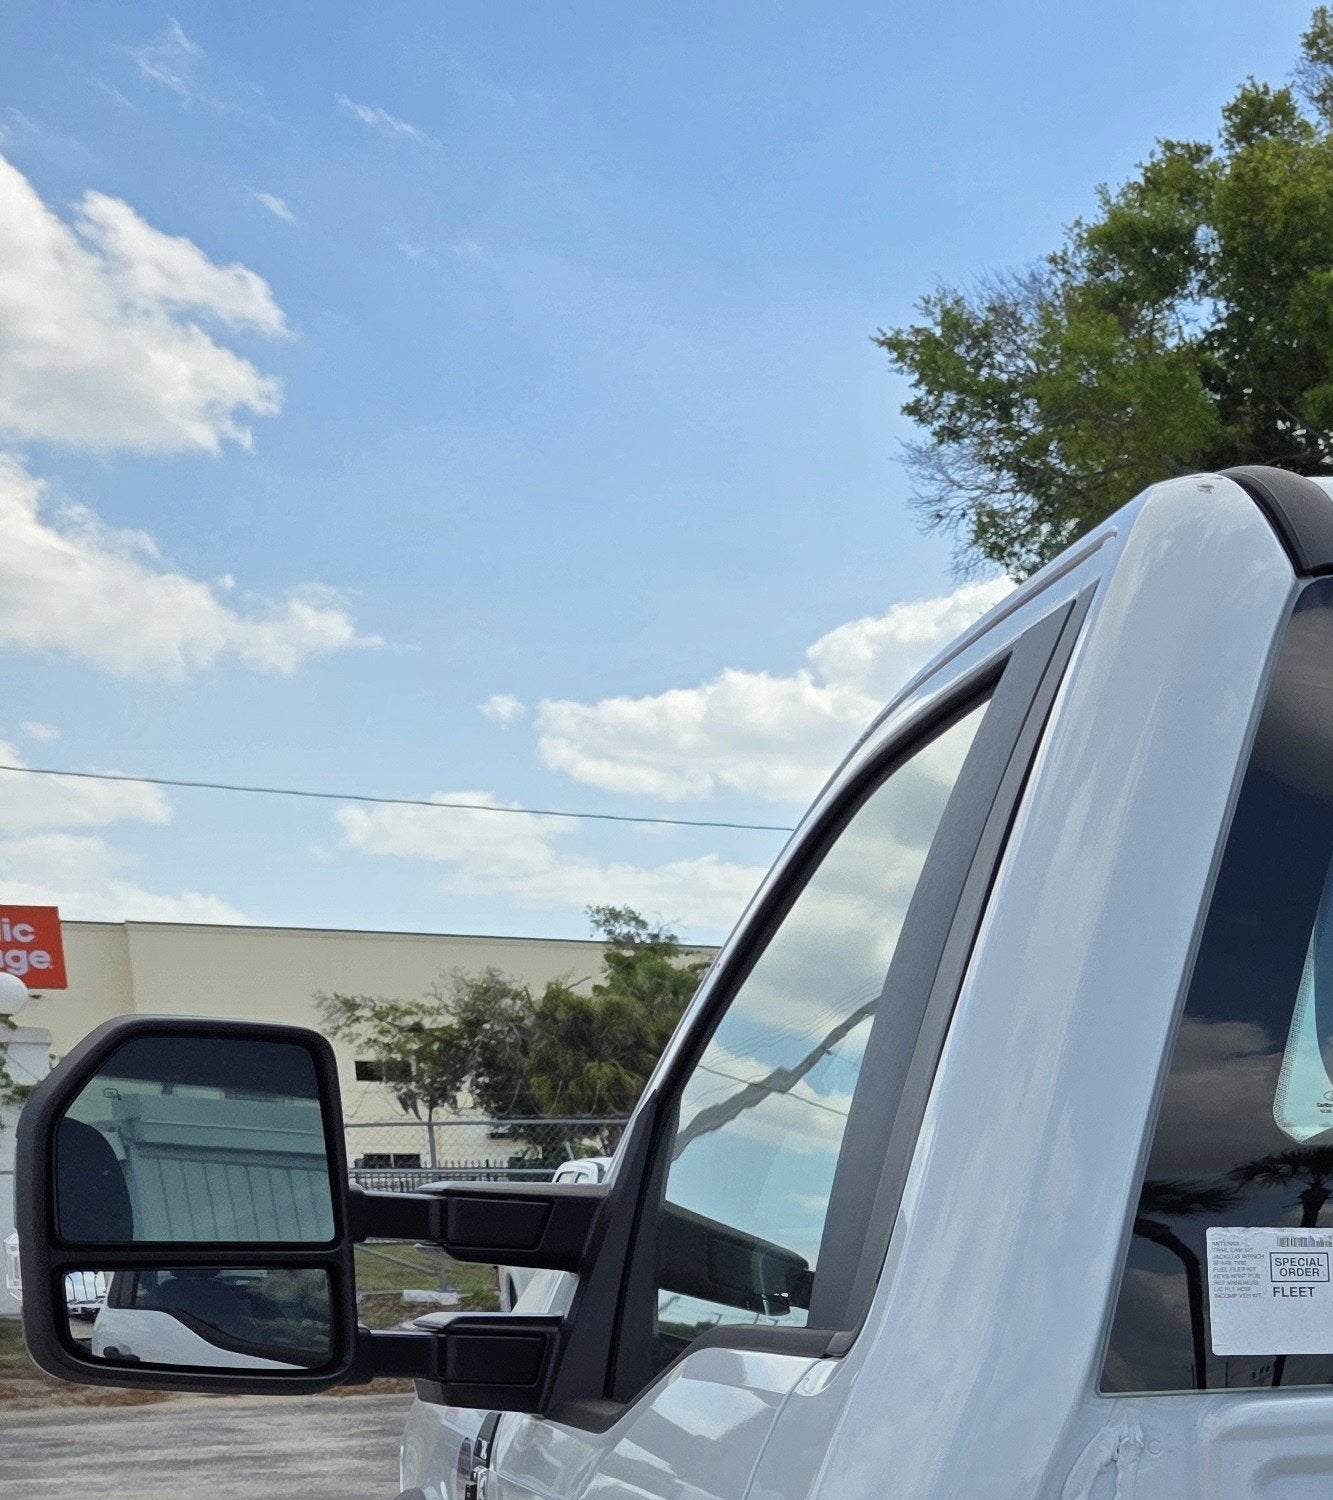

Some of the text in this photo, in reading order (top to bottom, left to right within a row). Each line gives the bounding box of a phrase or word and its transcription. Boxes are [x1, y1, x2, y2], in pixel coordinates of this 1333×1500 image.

[1274, 1257, 1324, 1267] SPECIAL
[1279, 1268, 1320, 1278] ORDER
[1273, 1286, 1316, 1298] FLEET
